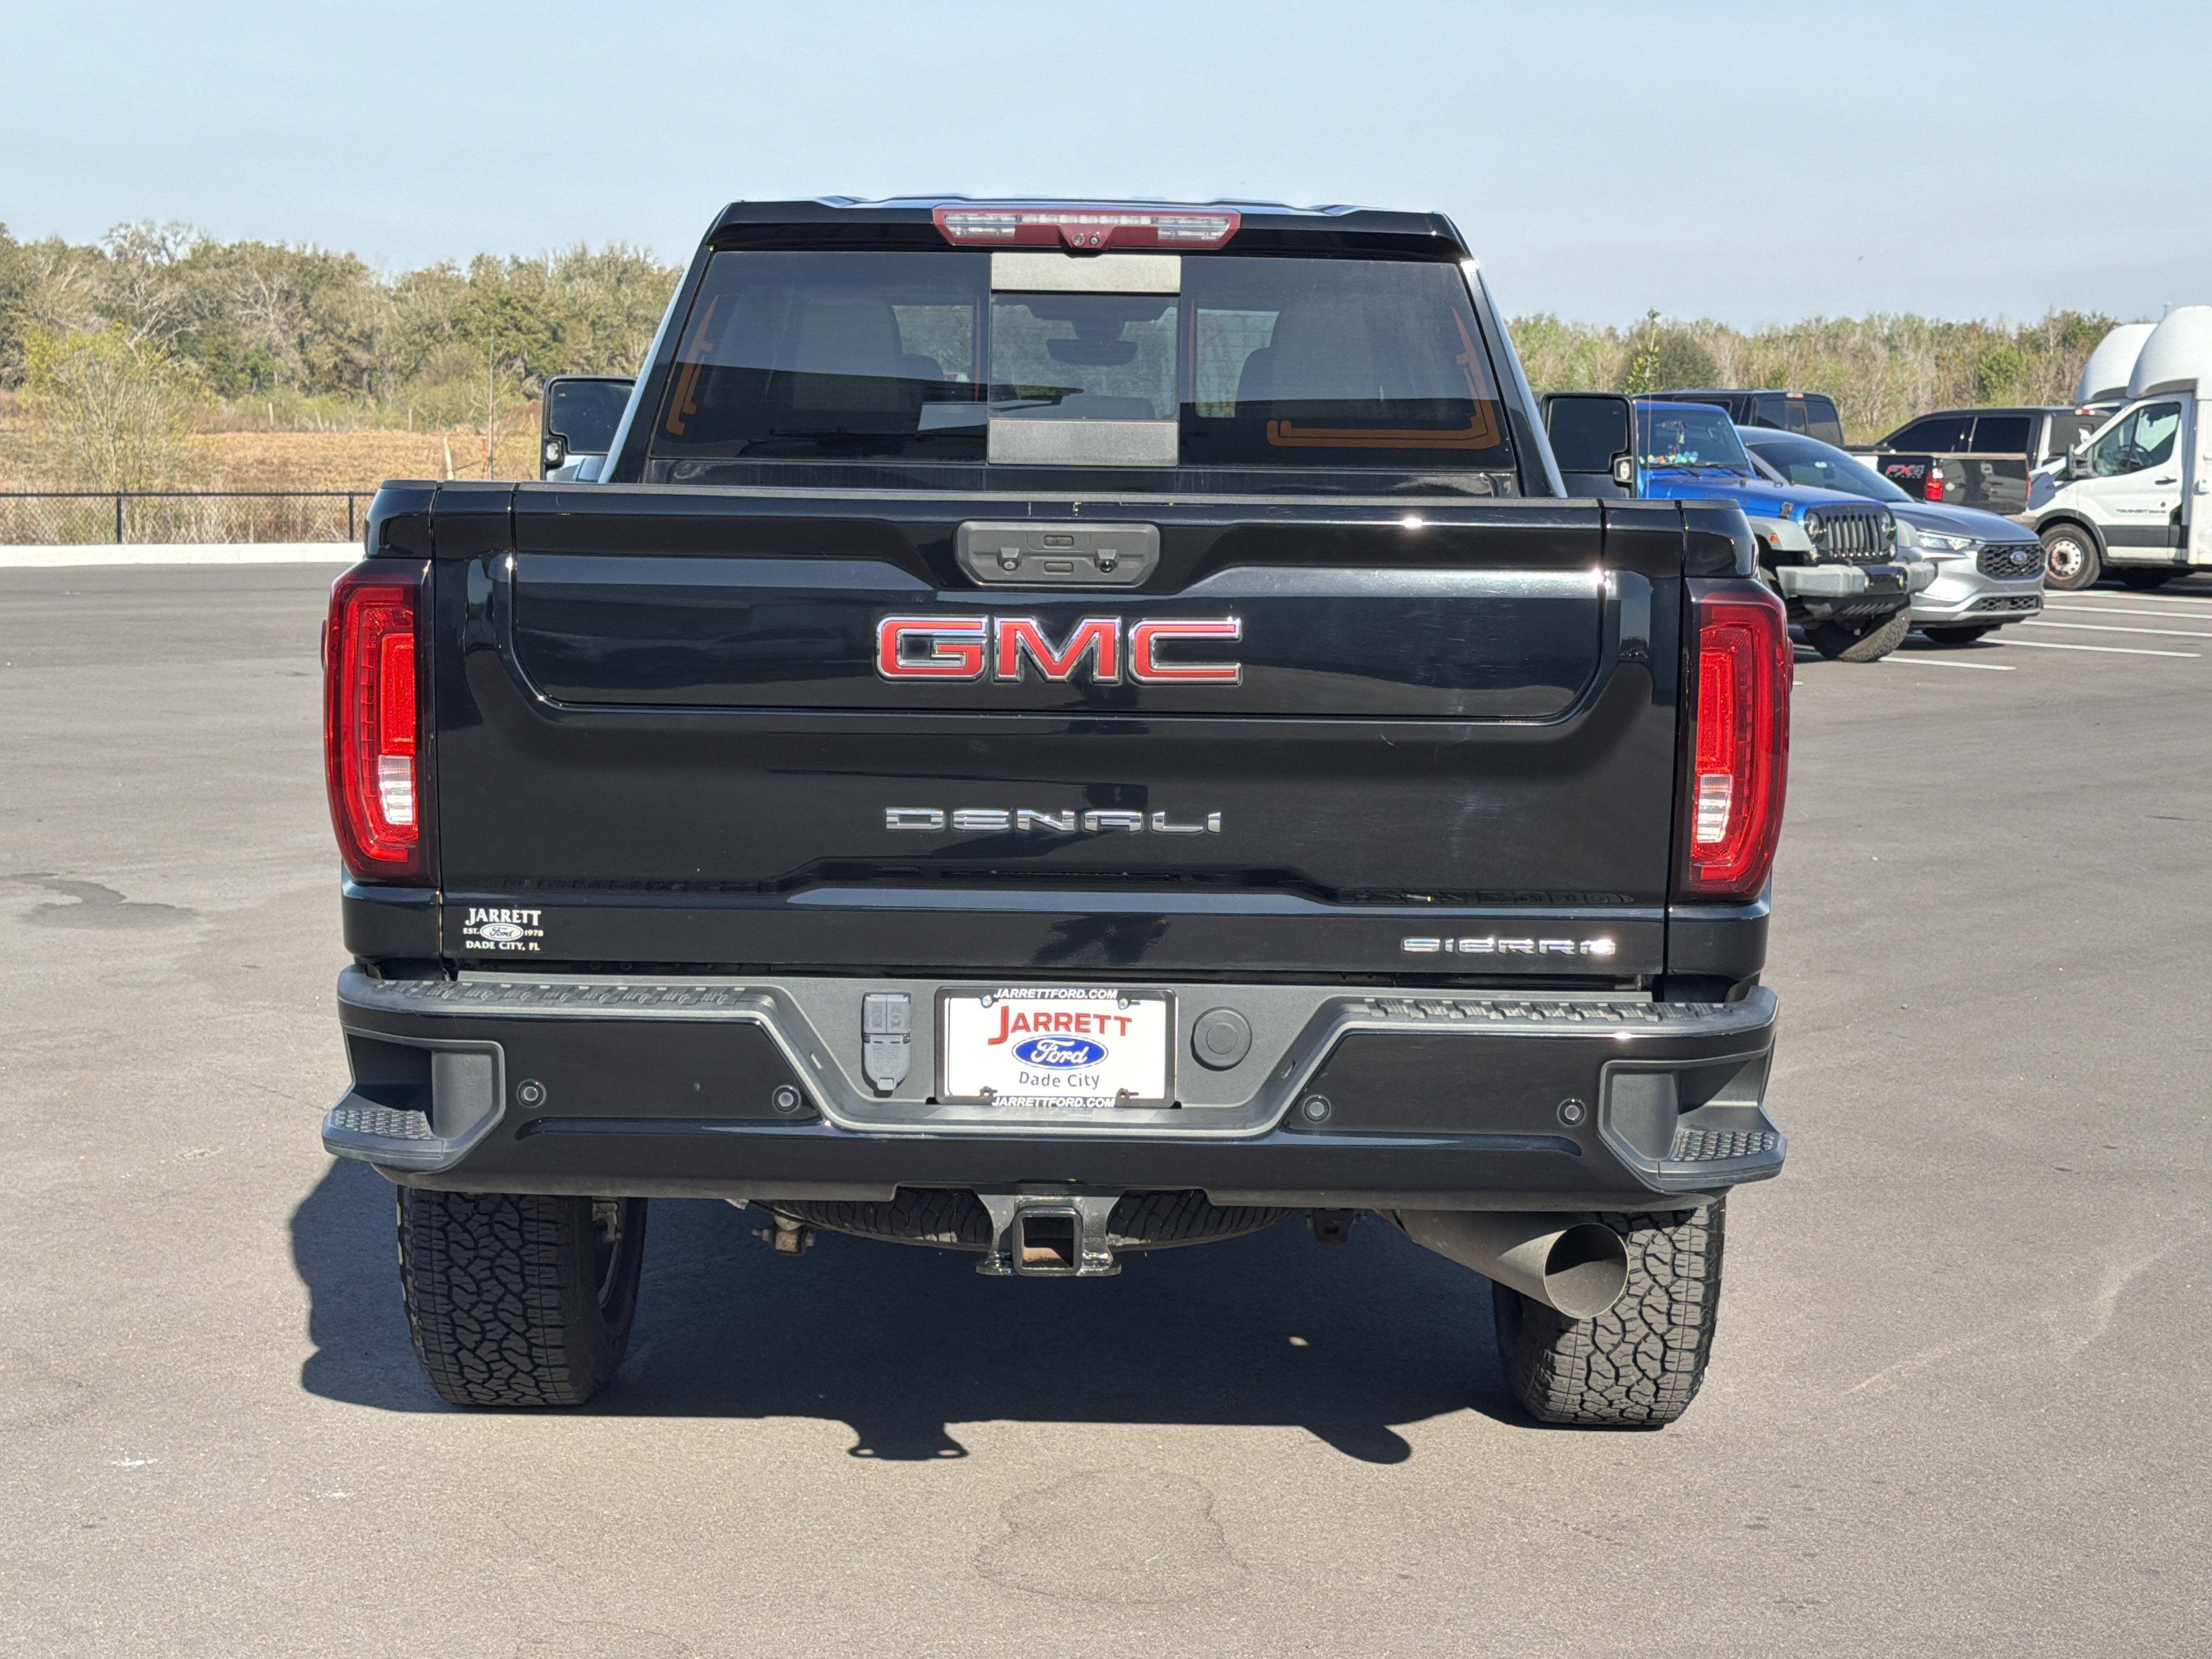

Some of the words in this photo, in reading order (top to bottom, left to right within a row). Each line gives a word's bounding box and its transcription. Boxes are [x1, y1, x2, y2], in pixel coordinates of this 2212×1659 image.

[1885, 464, 1925, 478] FX4
[877, 616, 1242, 685] GMC
[885, 808, 1221, 833] DENALI
[465, 908, 541, 926] JARRETT
[489, 927, 514, 937] Ford
[466, 941, 495, 949] DADE
[499, 942, 526, 951] CITY,
[529, 943, 540, 951] FL
[1403, 938, 1616, 956] SIERRA
[994, 989, 1118, 999] JARRETTFORD.COM
[988, 1006, 1132, 1045] JARRETT
[1030, 1040, 1089, 1064] Ford
[1019, 1071, 1060, 1087] Dade
[1068, 1074, 1100, 1090] City
[992, 1097, 1116, 1108] JARRETTFORD.COM
